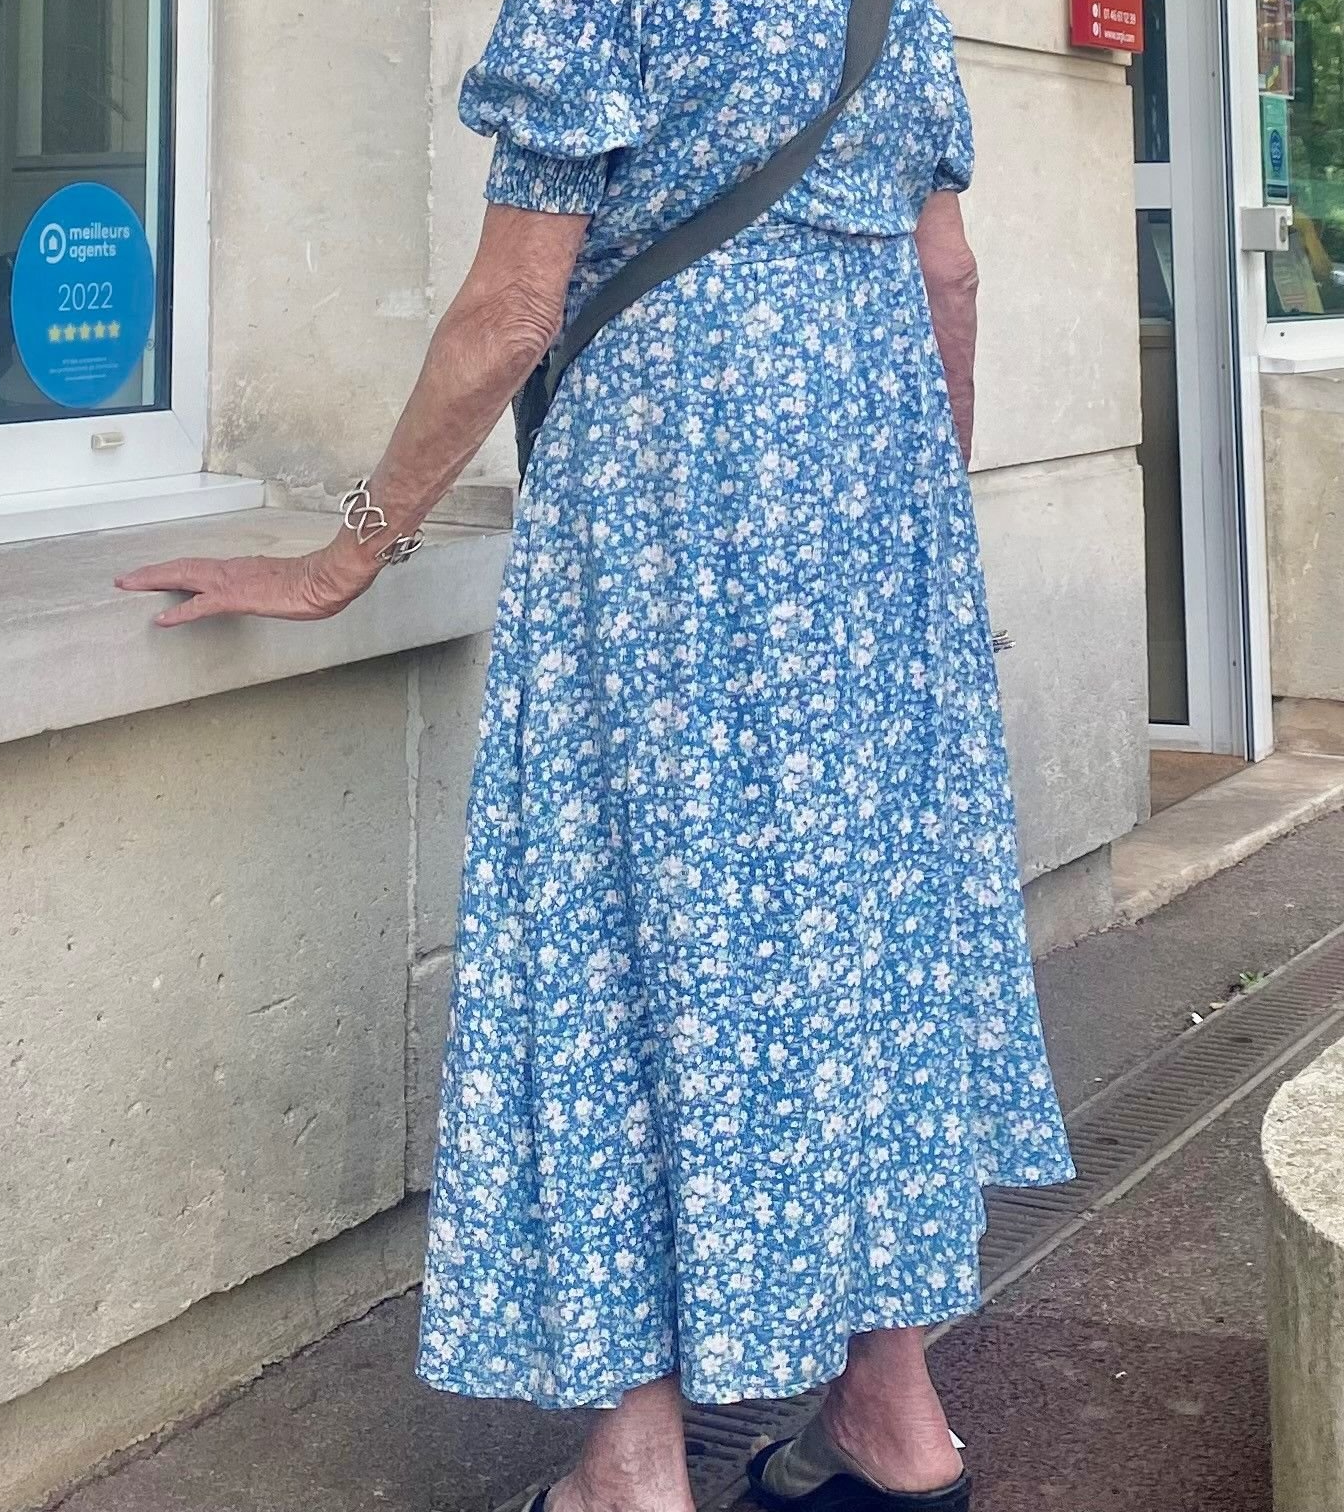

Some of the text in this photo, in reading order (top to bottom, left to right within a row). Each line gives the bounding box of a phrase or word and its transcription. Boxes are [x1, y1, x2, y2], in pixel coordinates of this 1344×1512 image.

[69, 222, 131, 241] meilleurs
[68, 241, 118, 263] agents
[57, 281, 114, 312] 2022
